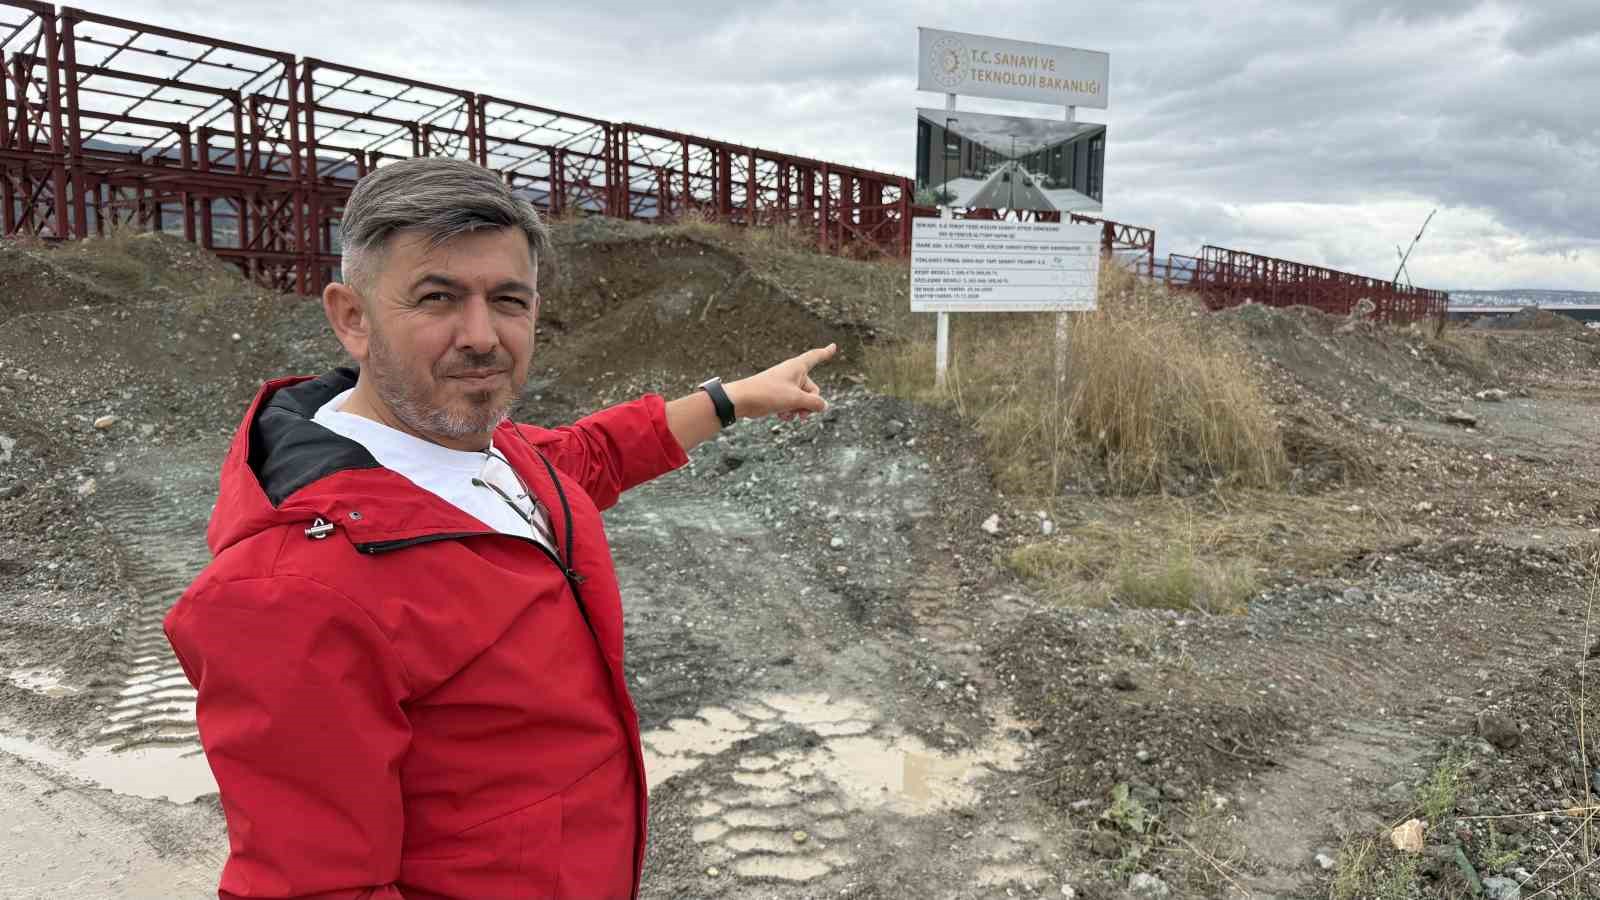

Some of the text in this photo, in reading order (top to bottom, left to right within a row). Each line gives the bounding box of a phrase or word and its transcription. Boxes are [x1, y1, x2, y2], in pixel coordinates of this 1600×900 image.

[971, 49, 991, 64] T.C.
[1040, 58, 1056, 72] VE
[1039, 76, 1101, 96] BAKANLIĞI
